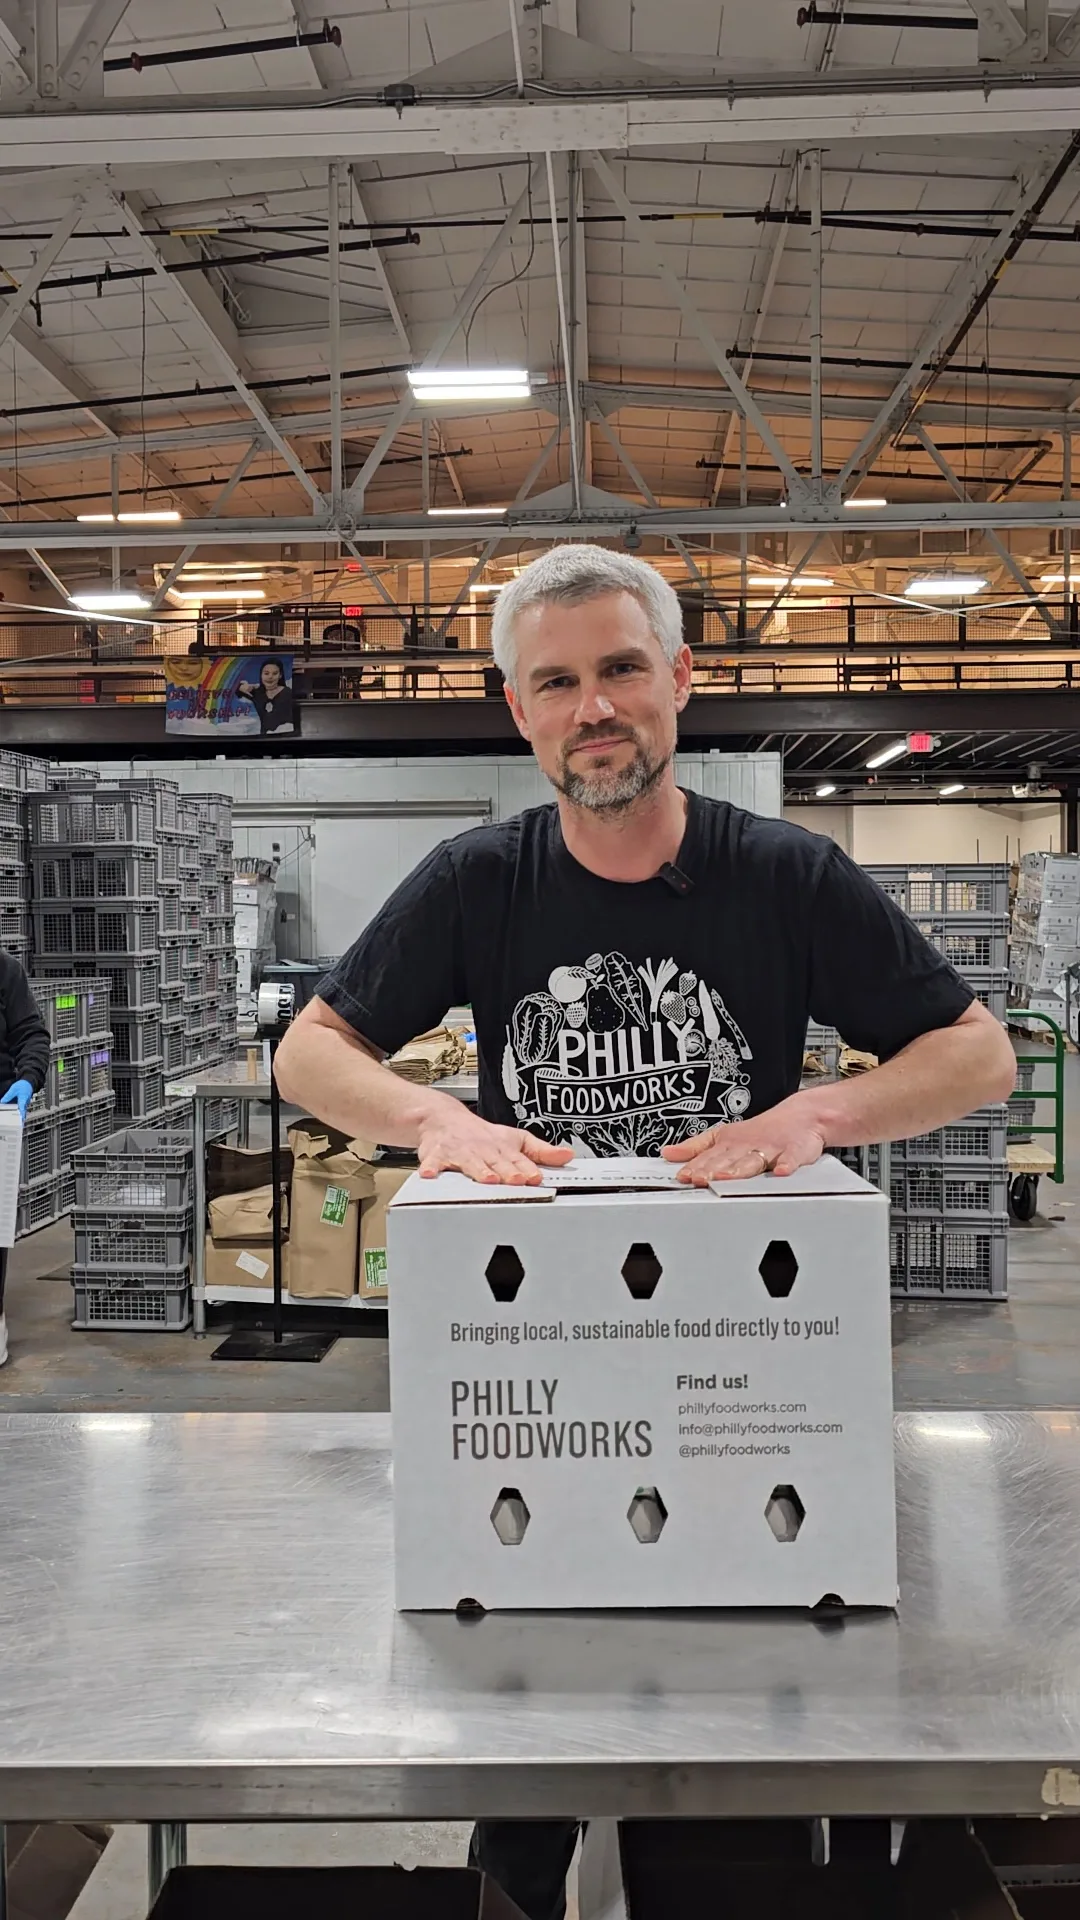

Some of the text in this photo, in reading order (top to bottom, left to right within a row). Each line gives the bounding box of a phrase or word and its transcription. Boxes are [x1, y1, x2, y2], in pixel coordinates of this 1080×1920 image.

[558, 1018, 696, 1078] PHILLY
[547, 1069, 696, 1113] FOODWORKS
[451, 1316, 840, 1345] Bringing local, sustainable food directly to you!
[676, 1374, 749, 1390] Find us!
[451, 1378, 558, 1417] PHILLY
[678, 1401, 807, 1416] phillyfoodworks.com
[452, 1420, 652, 1460] FOODWORKS
[678, 1422, 843, 1437] info@phillyfoodworks.com
[679, 1443, 791, 1458] @phillyfoodworks
